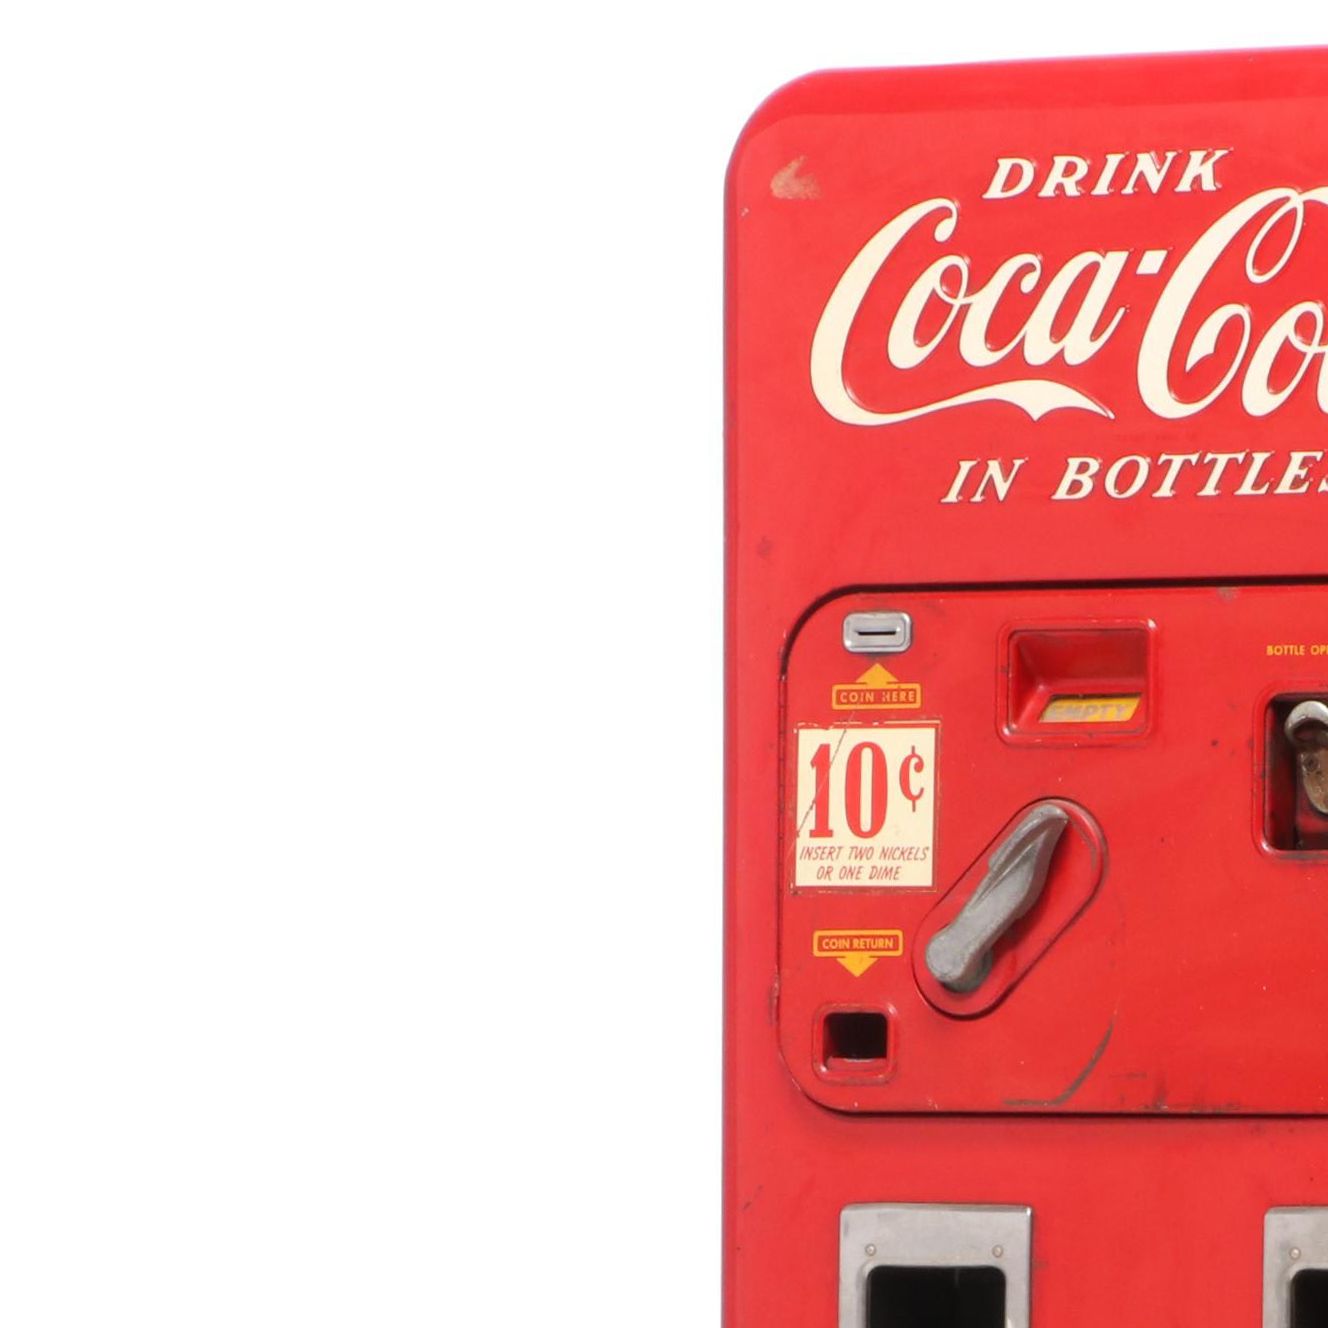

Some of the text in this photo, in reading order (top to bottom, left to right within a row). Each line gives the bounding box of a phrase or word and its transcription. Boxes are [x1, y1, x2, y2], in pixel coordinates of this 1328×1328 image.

[981, 148, 1232, 198] DRINK
[940, 457, 1029, 504] IN
[1266, 645, 1305, 656] BOTTLE
[840, 691, 915, 703] COIN HERE
[800, 846, 929, 861] INSERT TWO NICKELS
[816, 866, 902, 880] OR ONE DIME
[822, 938, 894, 949] COIN RETURN
